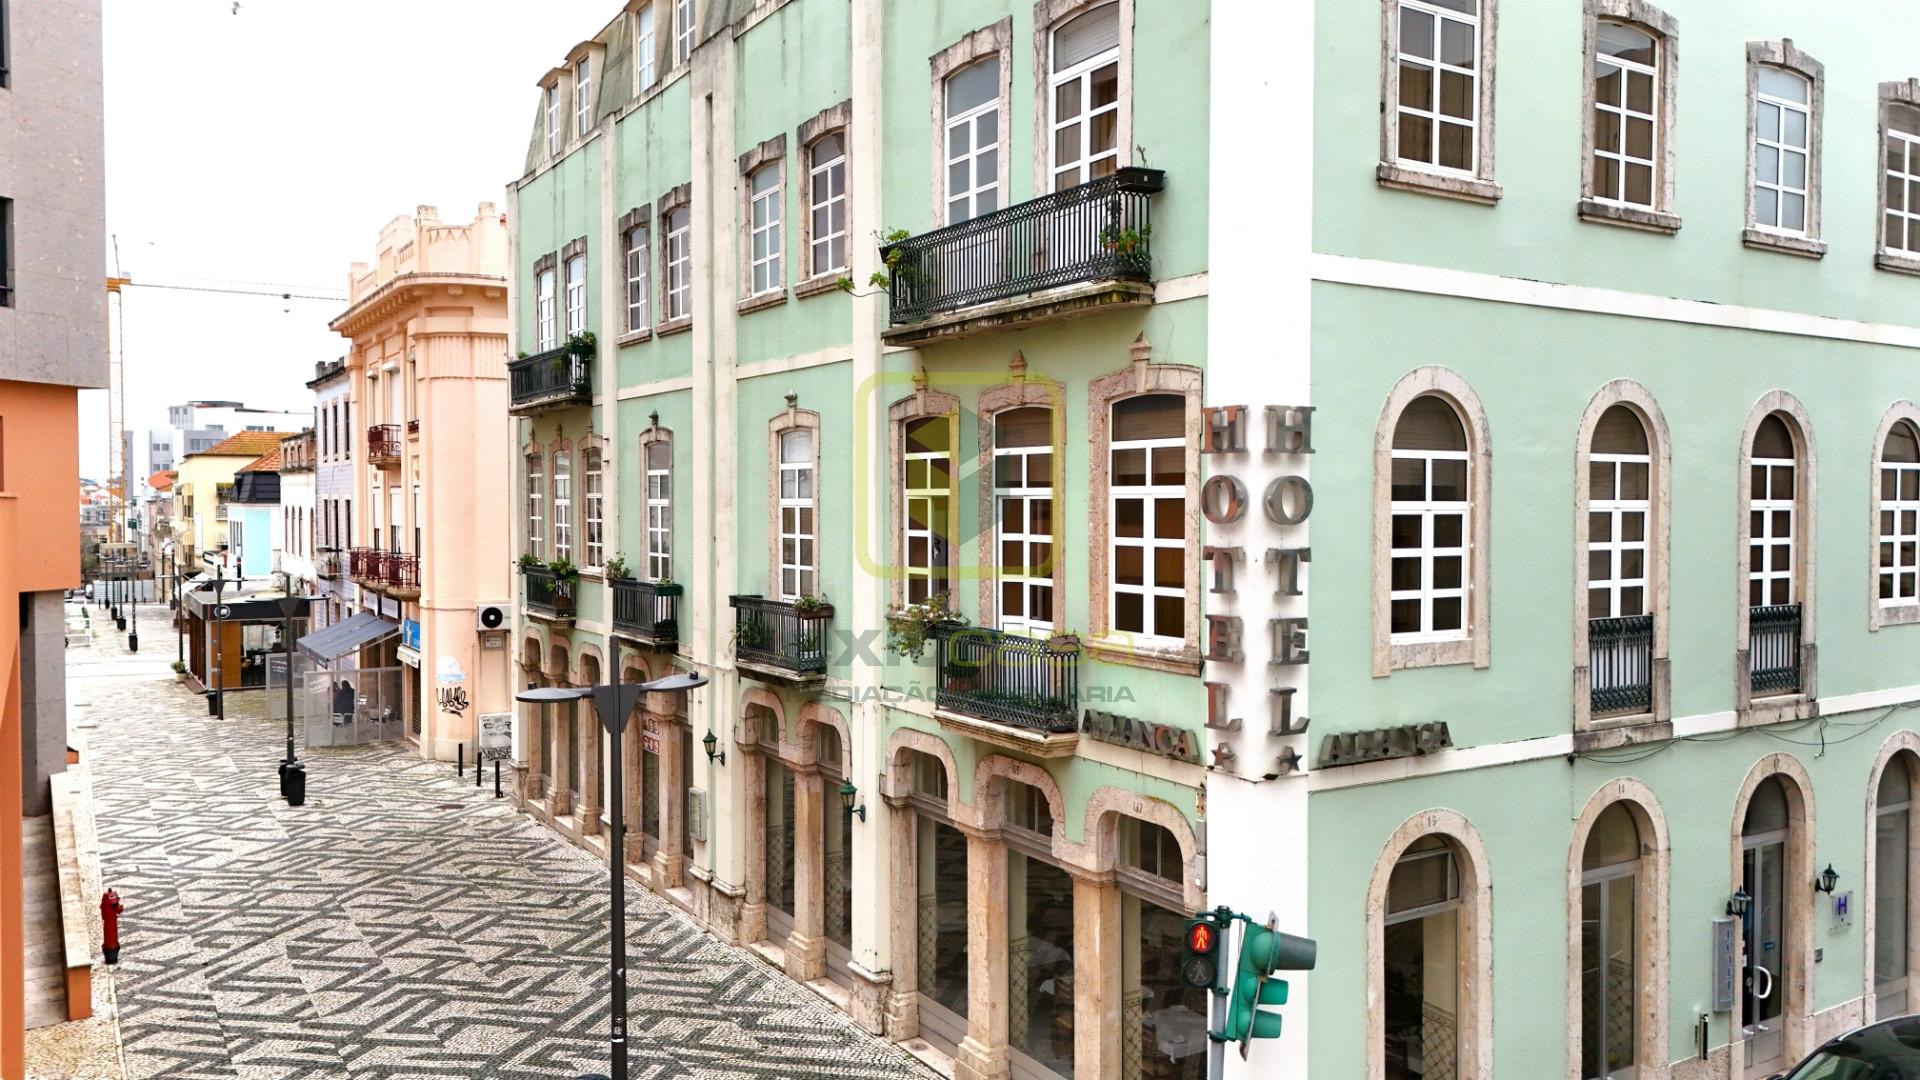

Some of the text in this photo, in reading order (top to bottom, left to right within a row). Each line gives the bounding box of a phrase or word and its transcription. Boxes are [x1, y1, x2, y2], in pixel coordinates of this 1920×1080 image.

[1200, 405, 1249, 733] HOTEL
[1263, 405, 1317, 737] HOTEL
[1080, 708, 1201, 762] ALIANÇA
[1318, 720, 1454, 768] ALIANÇA
